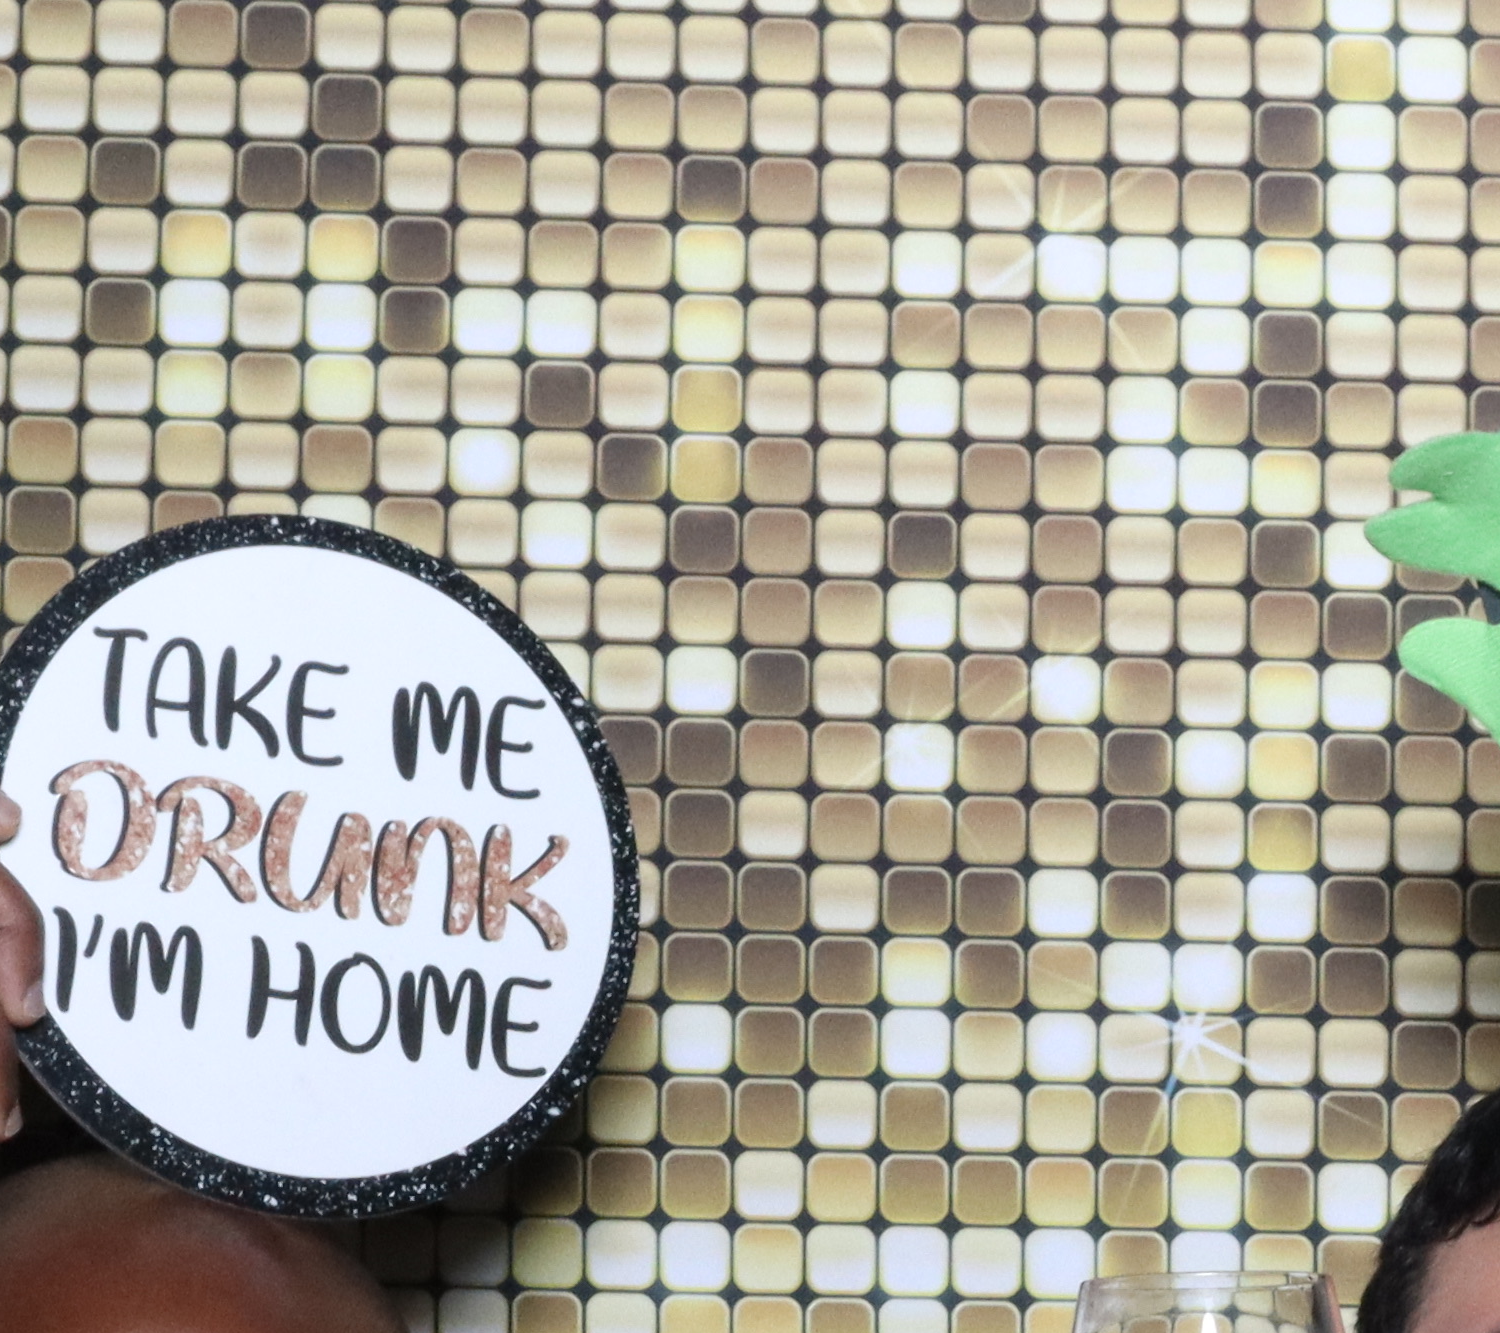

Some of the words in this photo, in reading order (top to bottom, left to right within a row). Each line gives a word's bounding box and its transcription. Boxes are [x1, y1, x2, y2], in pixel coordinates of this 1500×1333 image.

[94, 627, 349, 767] TAKE
[392, 681, 546, 800] ME
[48, 760, 568, 951] DRUNK
[53, 907, 203, 1030] I'M
[246, 936, 552, 1078] HOME
